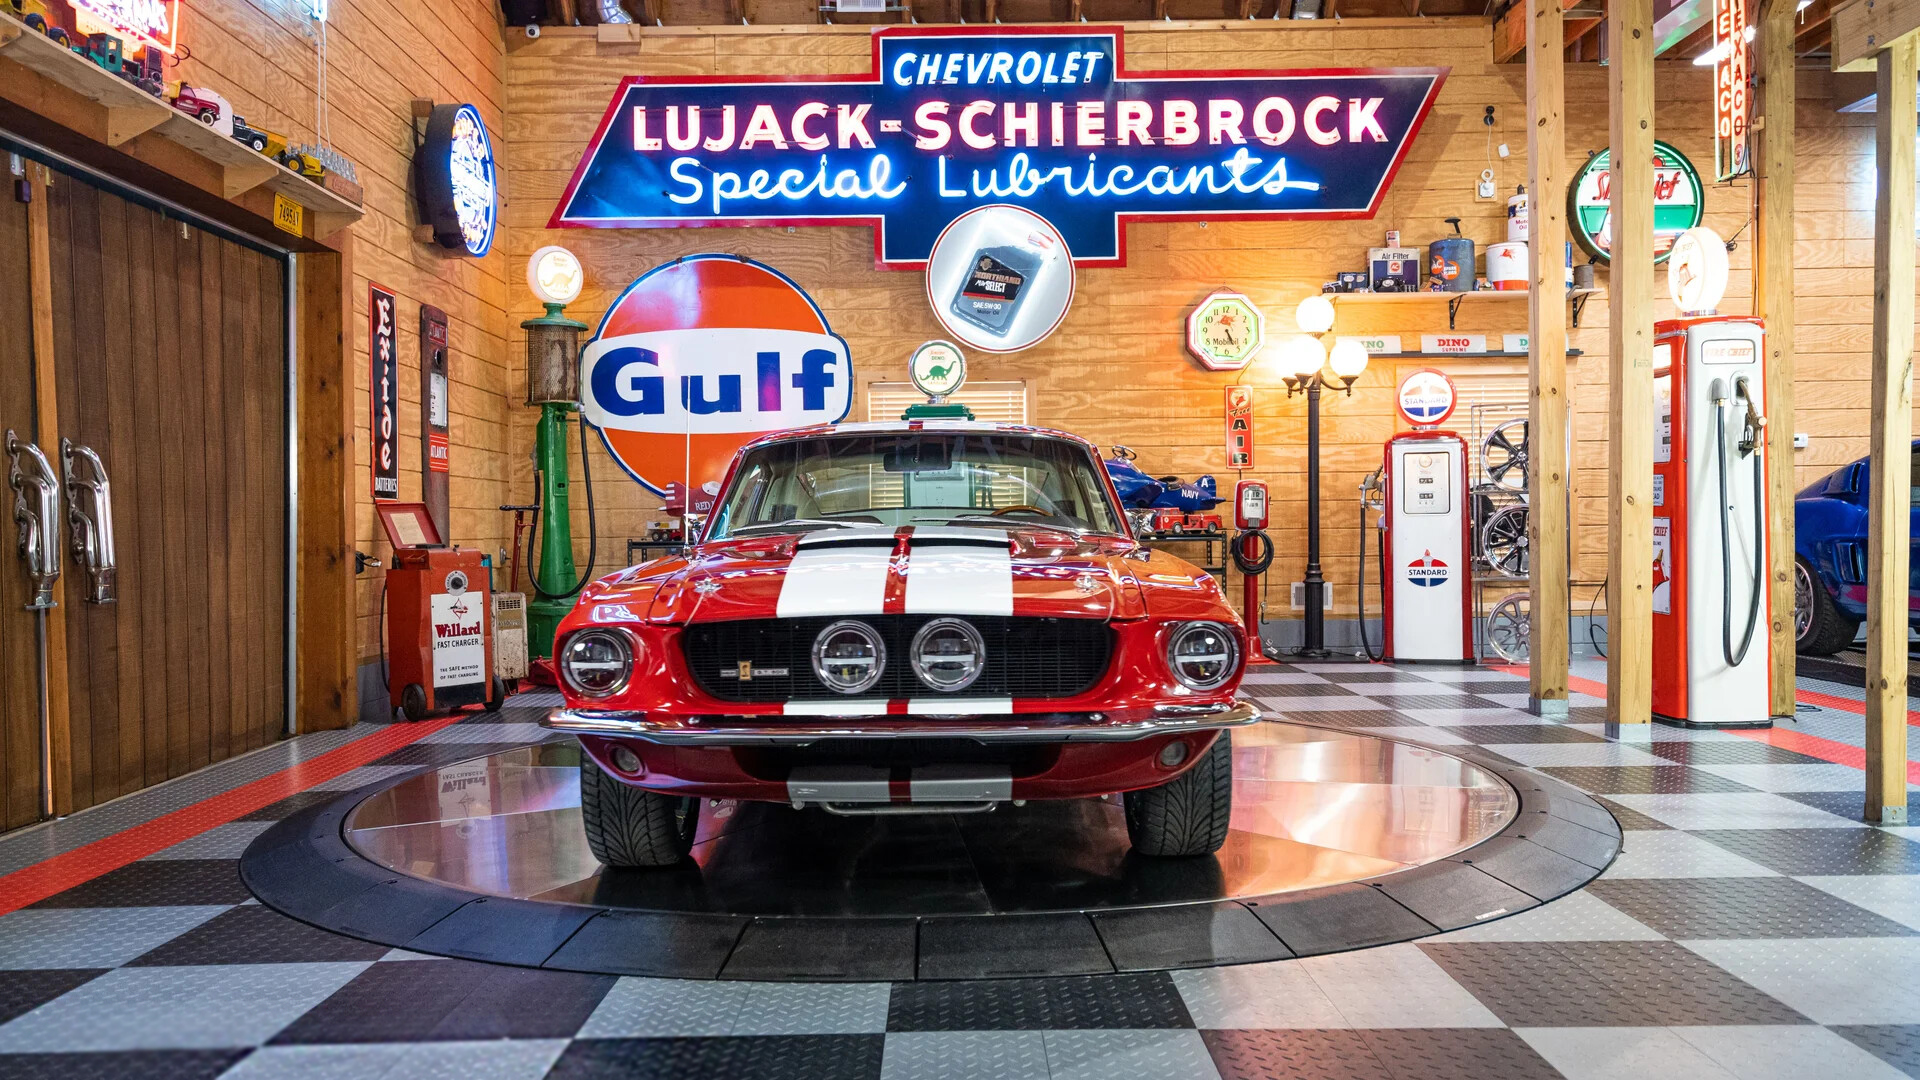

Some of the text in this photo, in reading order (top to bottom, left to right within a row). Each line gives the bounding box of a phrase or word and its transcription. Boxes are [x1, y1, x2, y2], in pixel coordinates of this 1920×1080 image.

[893, 50, 1104, 87] CHEVROLET
[1719, 0, 1731, 137] EACO
[668, 147, 1321, 214] Special Lubricants
[1392, 252, 1410, 260] Filter
[1437, 338, 1471, 347] DINO
[376, 298, 392, 471] Exide
[590, 346, 838, 417] Gulf
[1231, 418, 1249, 464] AIR
[431, 444, 448, 460] ATLANTIC
[374, 476, 398, 493] BATTERIES
[1201, 478, 1209, 488] A
[1181, 489, 1199, 500] NAVY
[695, 501, 711, 511] RED
[435, 621, 481, 639] Willard
[437, 638, 479, 649] FAST CHARGER
